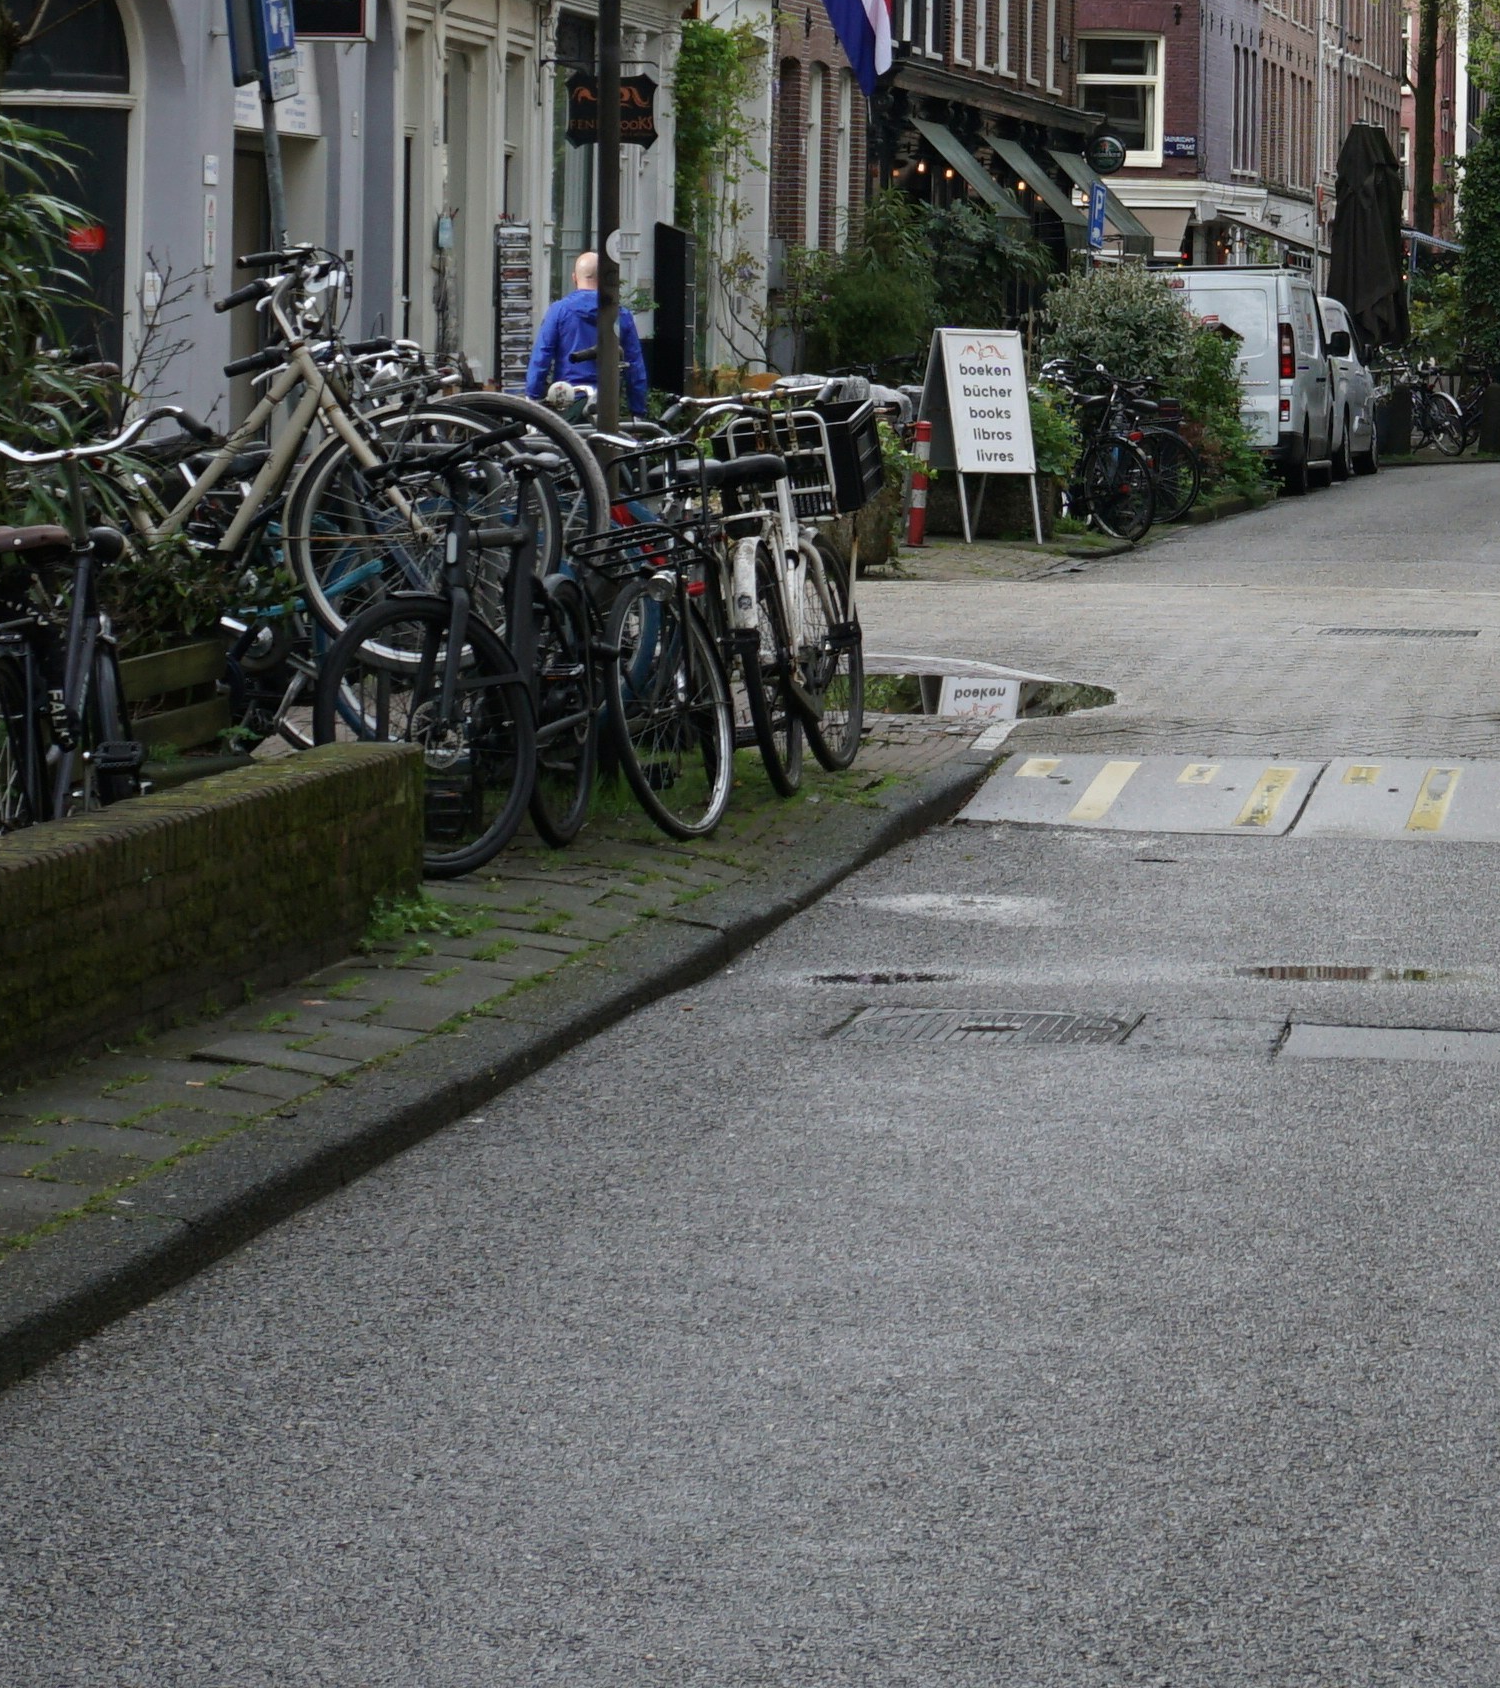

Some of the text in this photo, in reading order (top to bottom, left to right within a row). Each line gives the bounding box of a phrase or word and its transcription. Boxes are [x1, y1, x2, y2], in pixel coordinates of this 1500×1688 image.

[1094, 190, 1103, 220] P
[959, 363, 1011, 376] boeken
[963, 385, 1012, 398] bücher
[969, 407, 1011, 419] books
[973, 428, 1012, 440] libros
[977, 449, 1014, 462] livres
